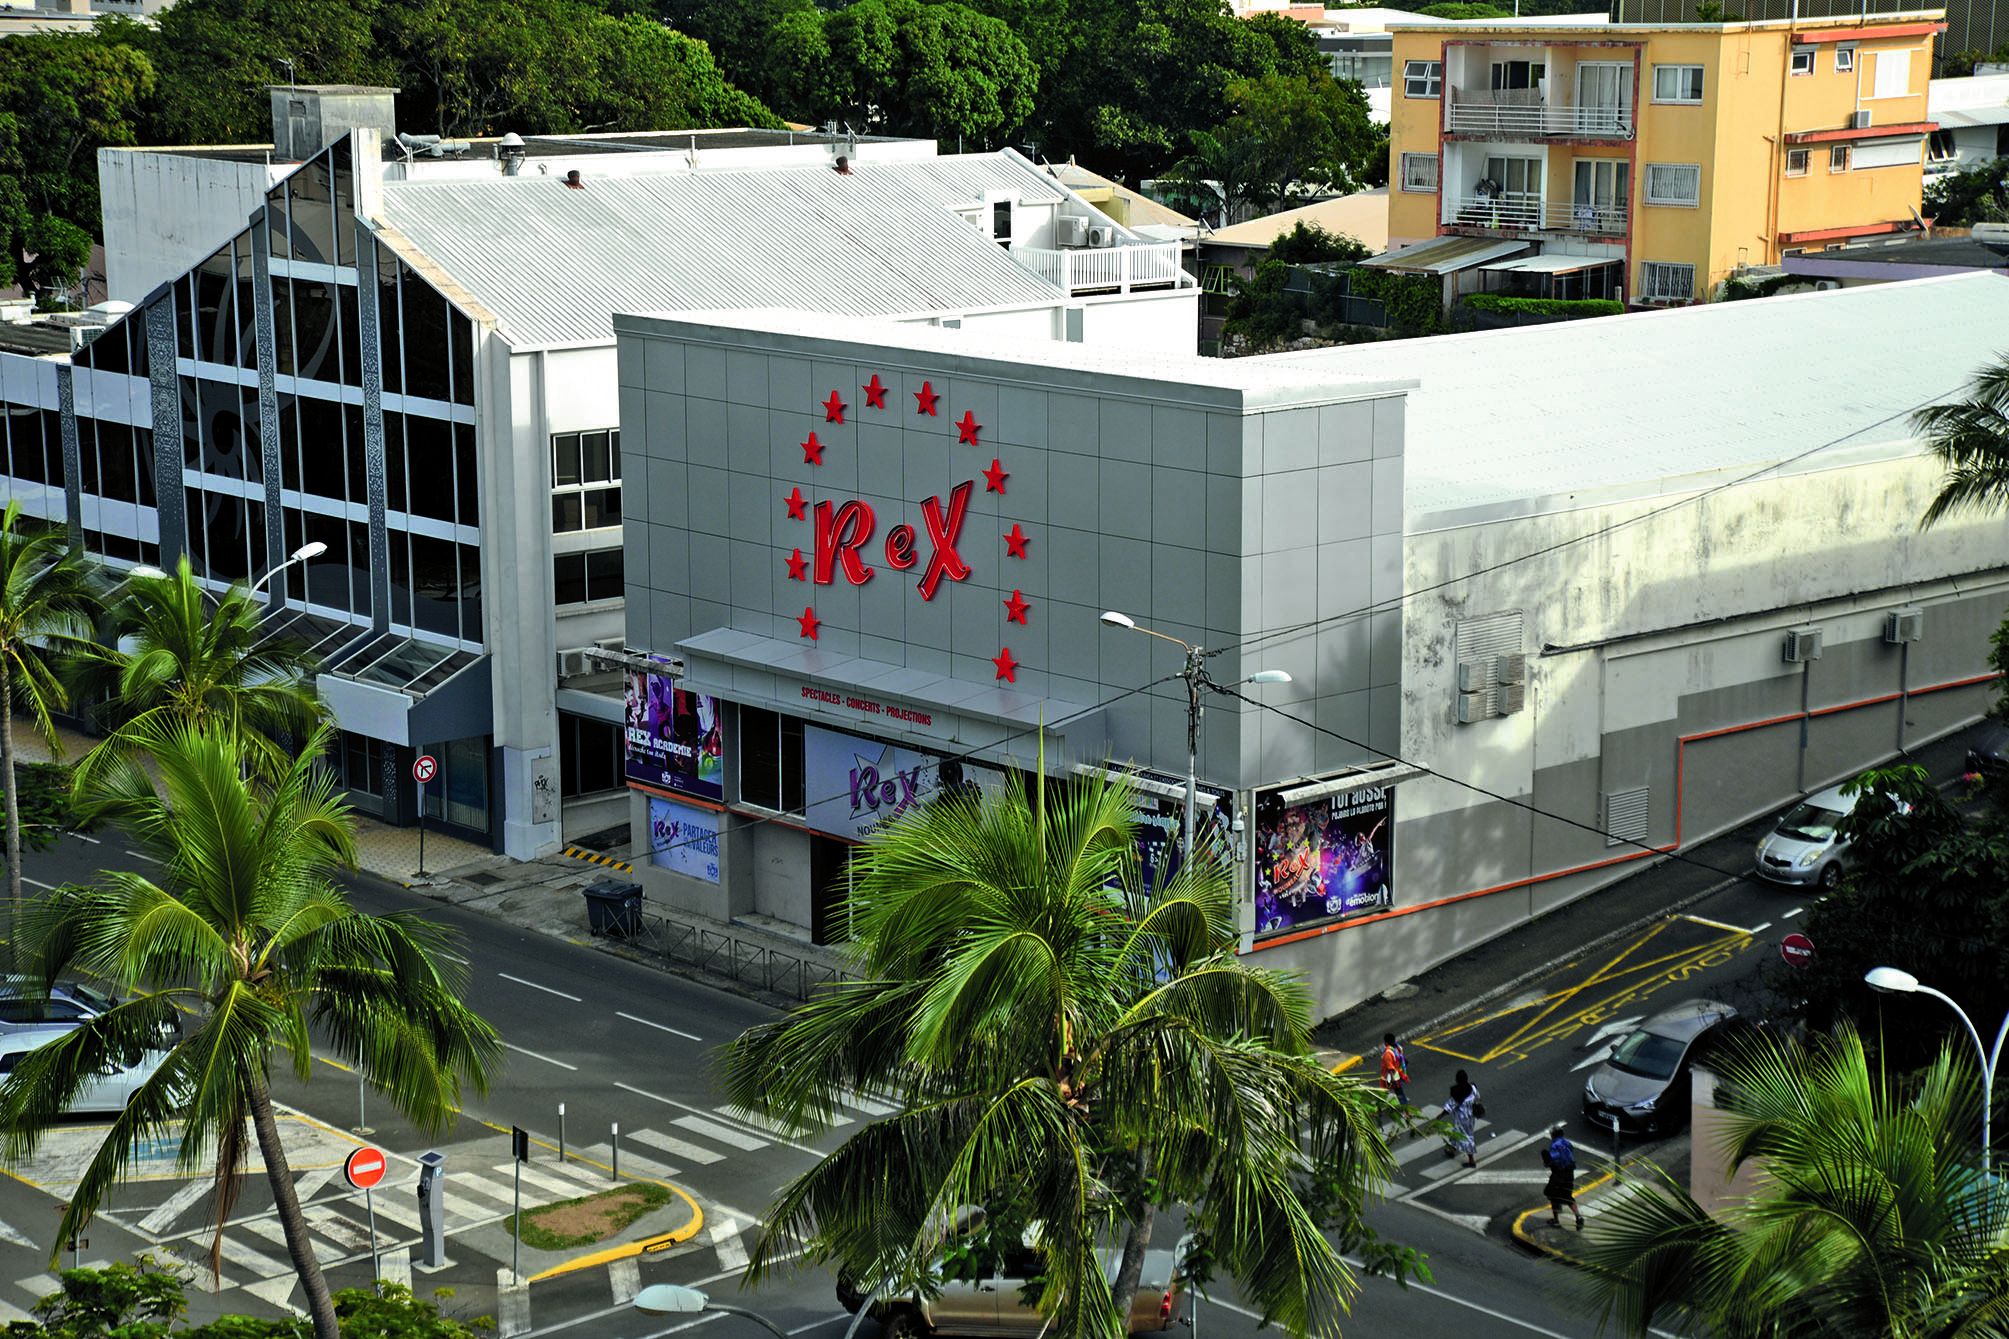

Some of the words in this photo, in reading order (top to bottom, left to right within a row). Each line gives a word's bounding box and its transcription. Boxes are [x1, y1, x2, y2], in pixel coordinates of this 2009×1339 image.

[801, 686, 841, 705] SPECTACLES
[846, 696, 881, 714] CONCERTS
[886, 705, 932, 726] PROJECTIONS
[628, 726, 652, 747] REX
[436, 1166, 442, 1177] P
